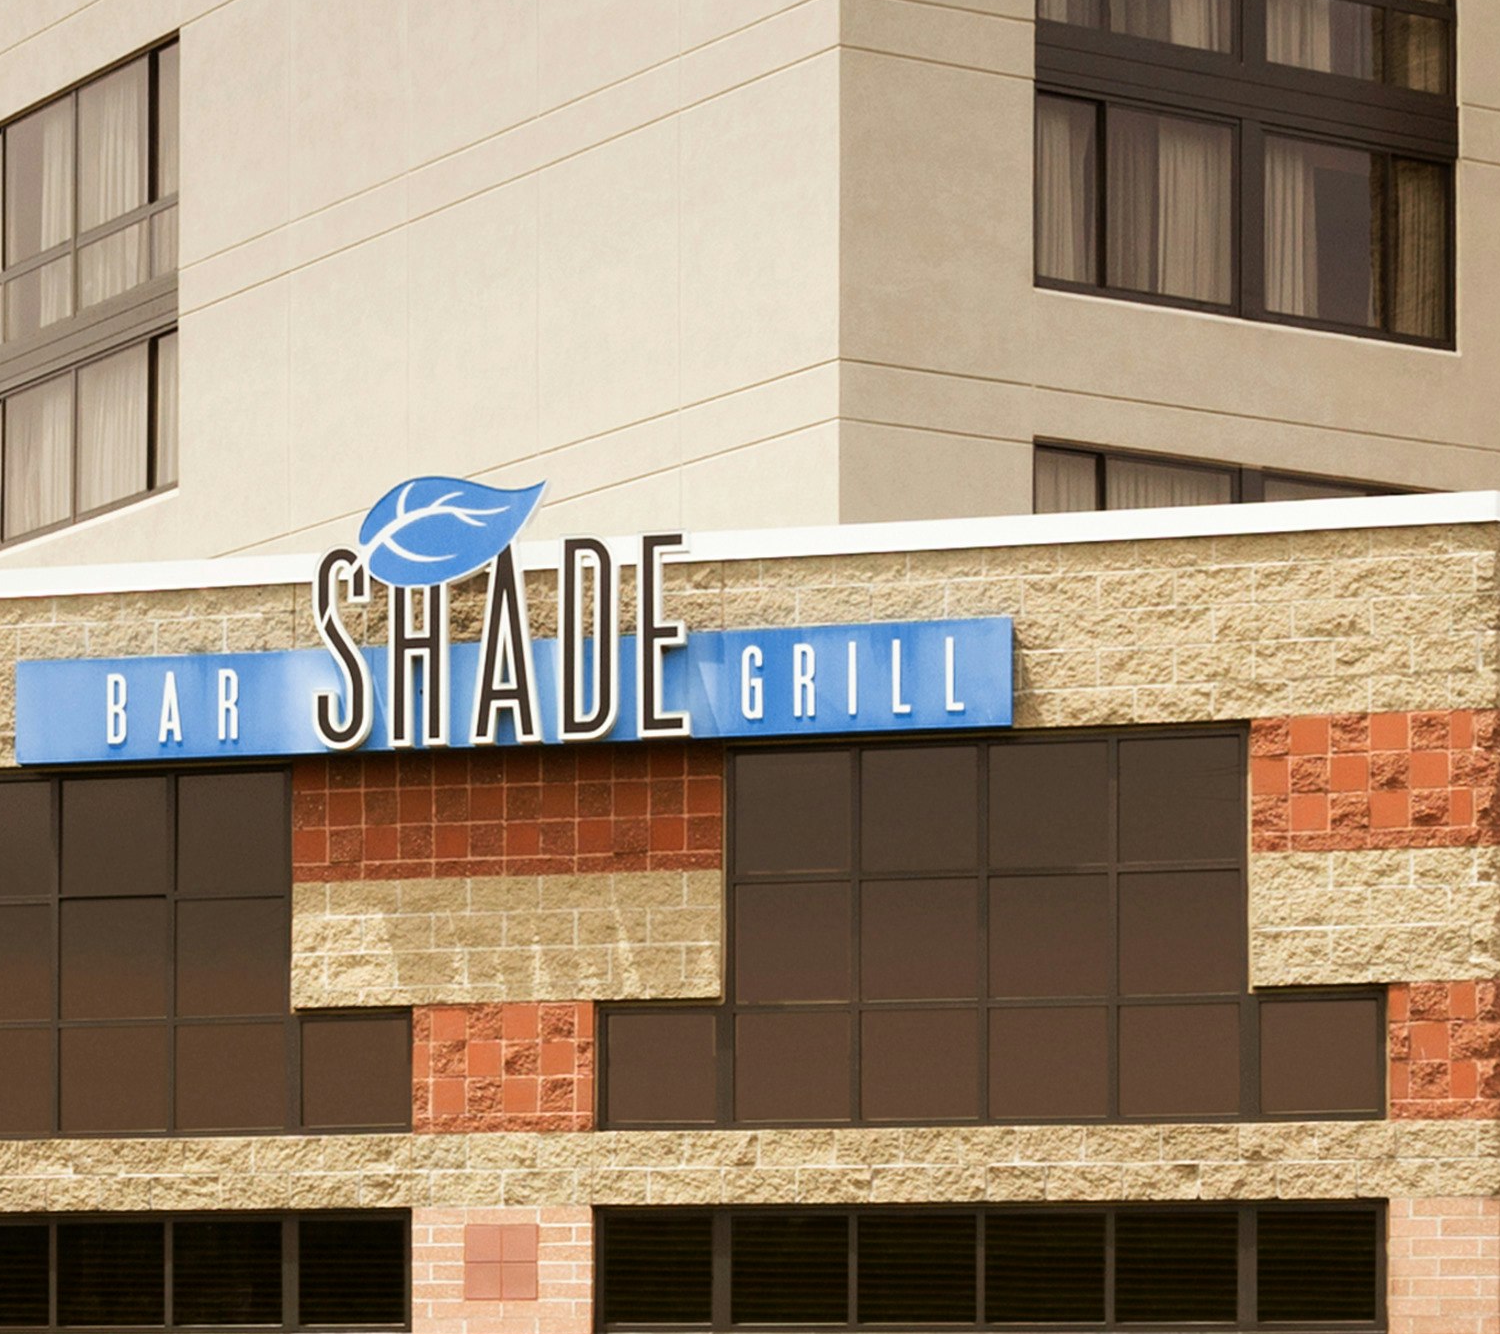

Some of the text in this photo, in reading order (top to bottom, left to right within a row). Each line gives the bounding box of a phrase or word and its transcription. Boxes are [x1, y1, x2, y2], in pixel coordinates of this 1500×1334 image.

[106, 531, 965, 751] BAR SHADE GRILL
